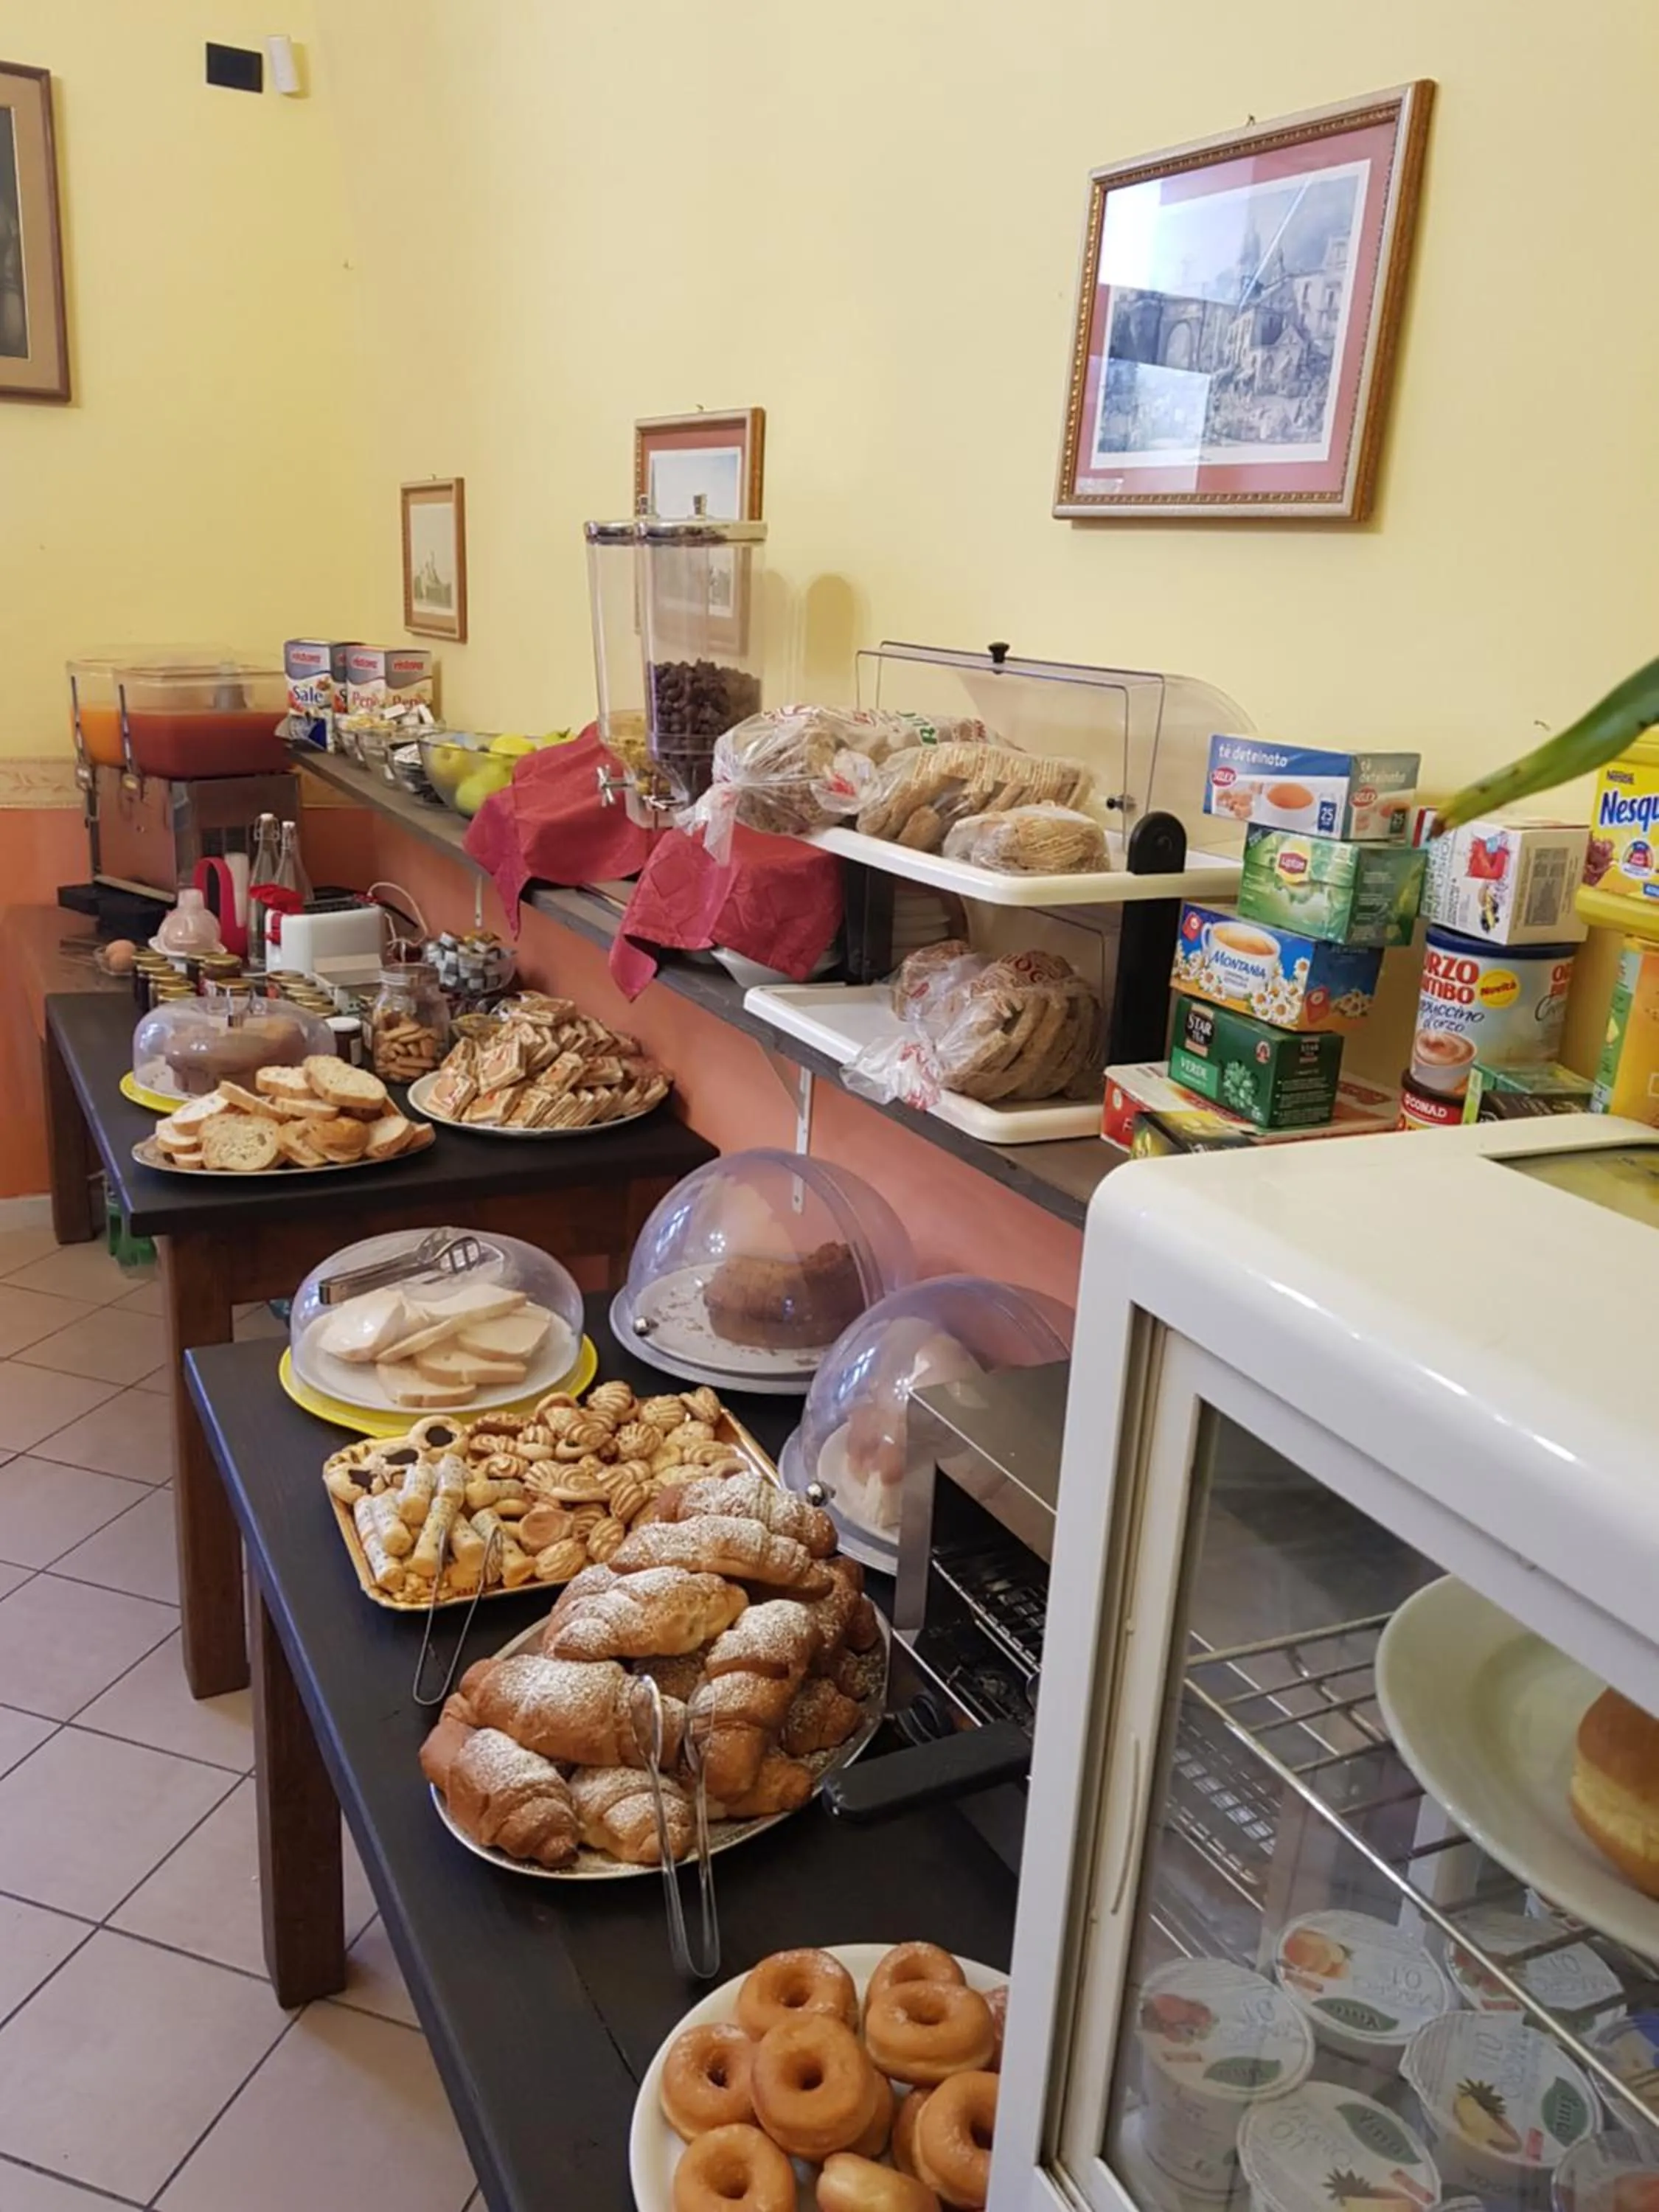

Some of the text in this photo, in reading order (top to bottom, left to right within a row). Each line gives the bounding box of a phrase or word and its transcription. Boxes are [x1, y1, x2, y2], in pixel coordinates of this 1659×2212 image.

[293, 686, 324, 703] Sale
[1231, 746, 1288, 768] deteinato
[1320, 806, 1334, 821] 25
[1281, 855, 1306, 872] Lipton
[1480, 979, 1517, 996] Novità
[1188, 1013, 1211, 1036] STAR
[1180, 1056, 1208, 1079] VERDE
[1410, 1096, 1448, 1118] CONAD
